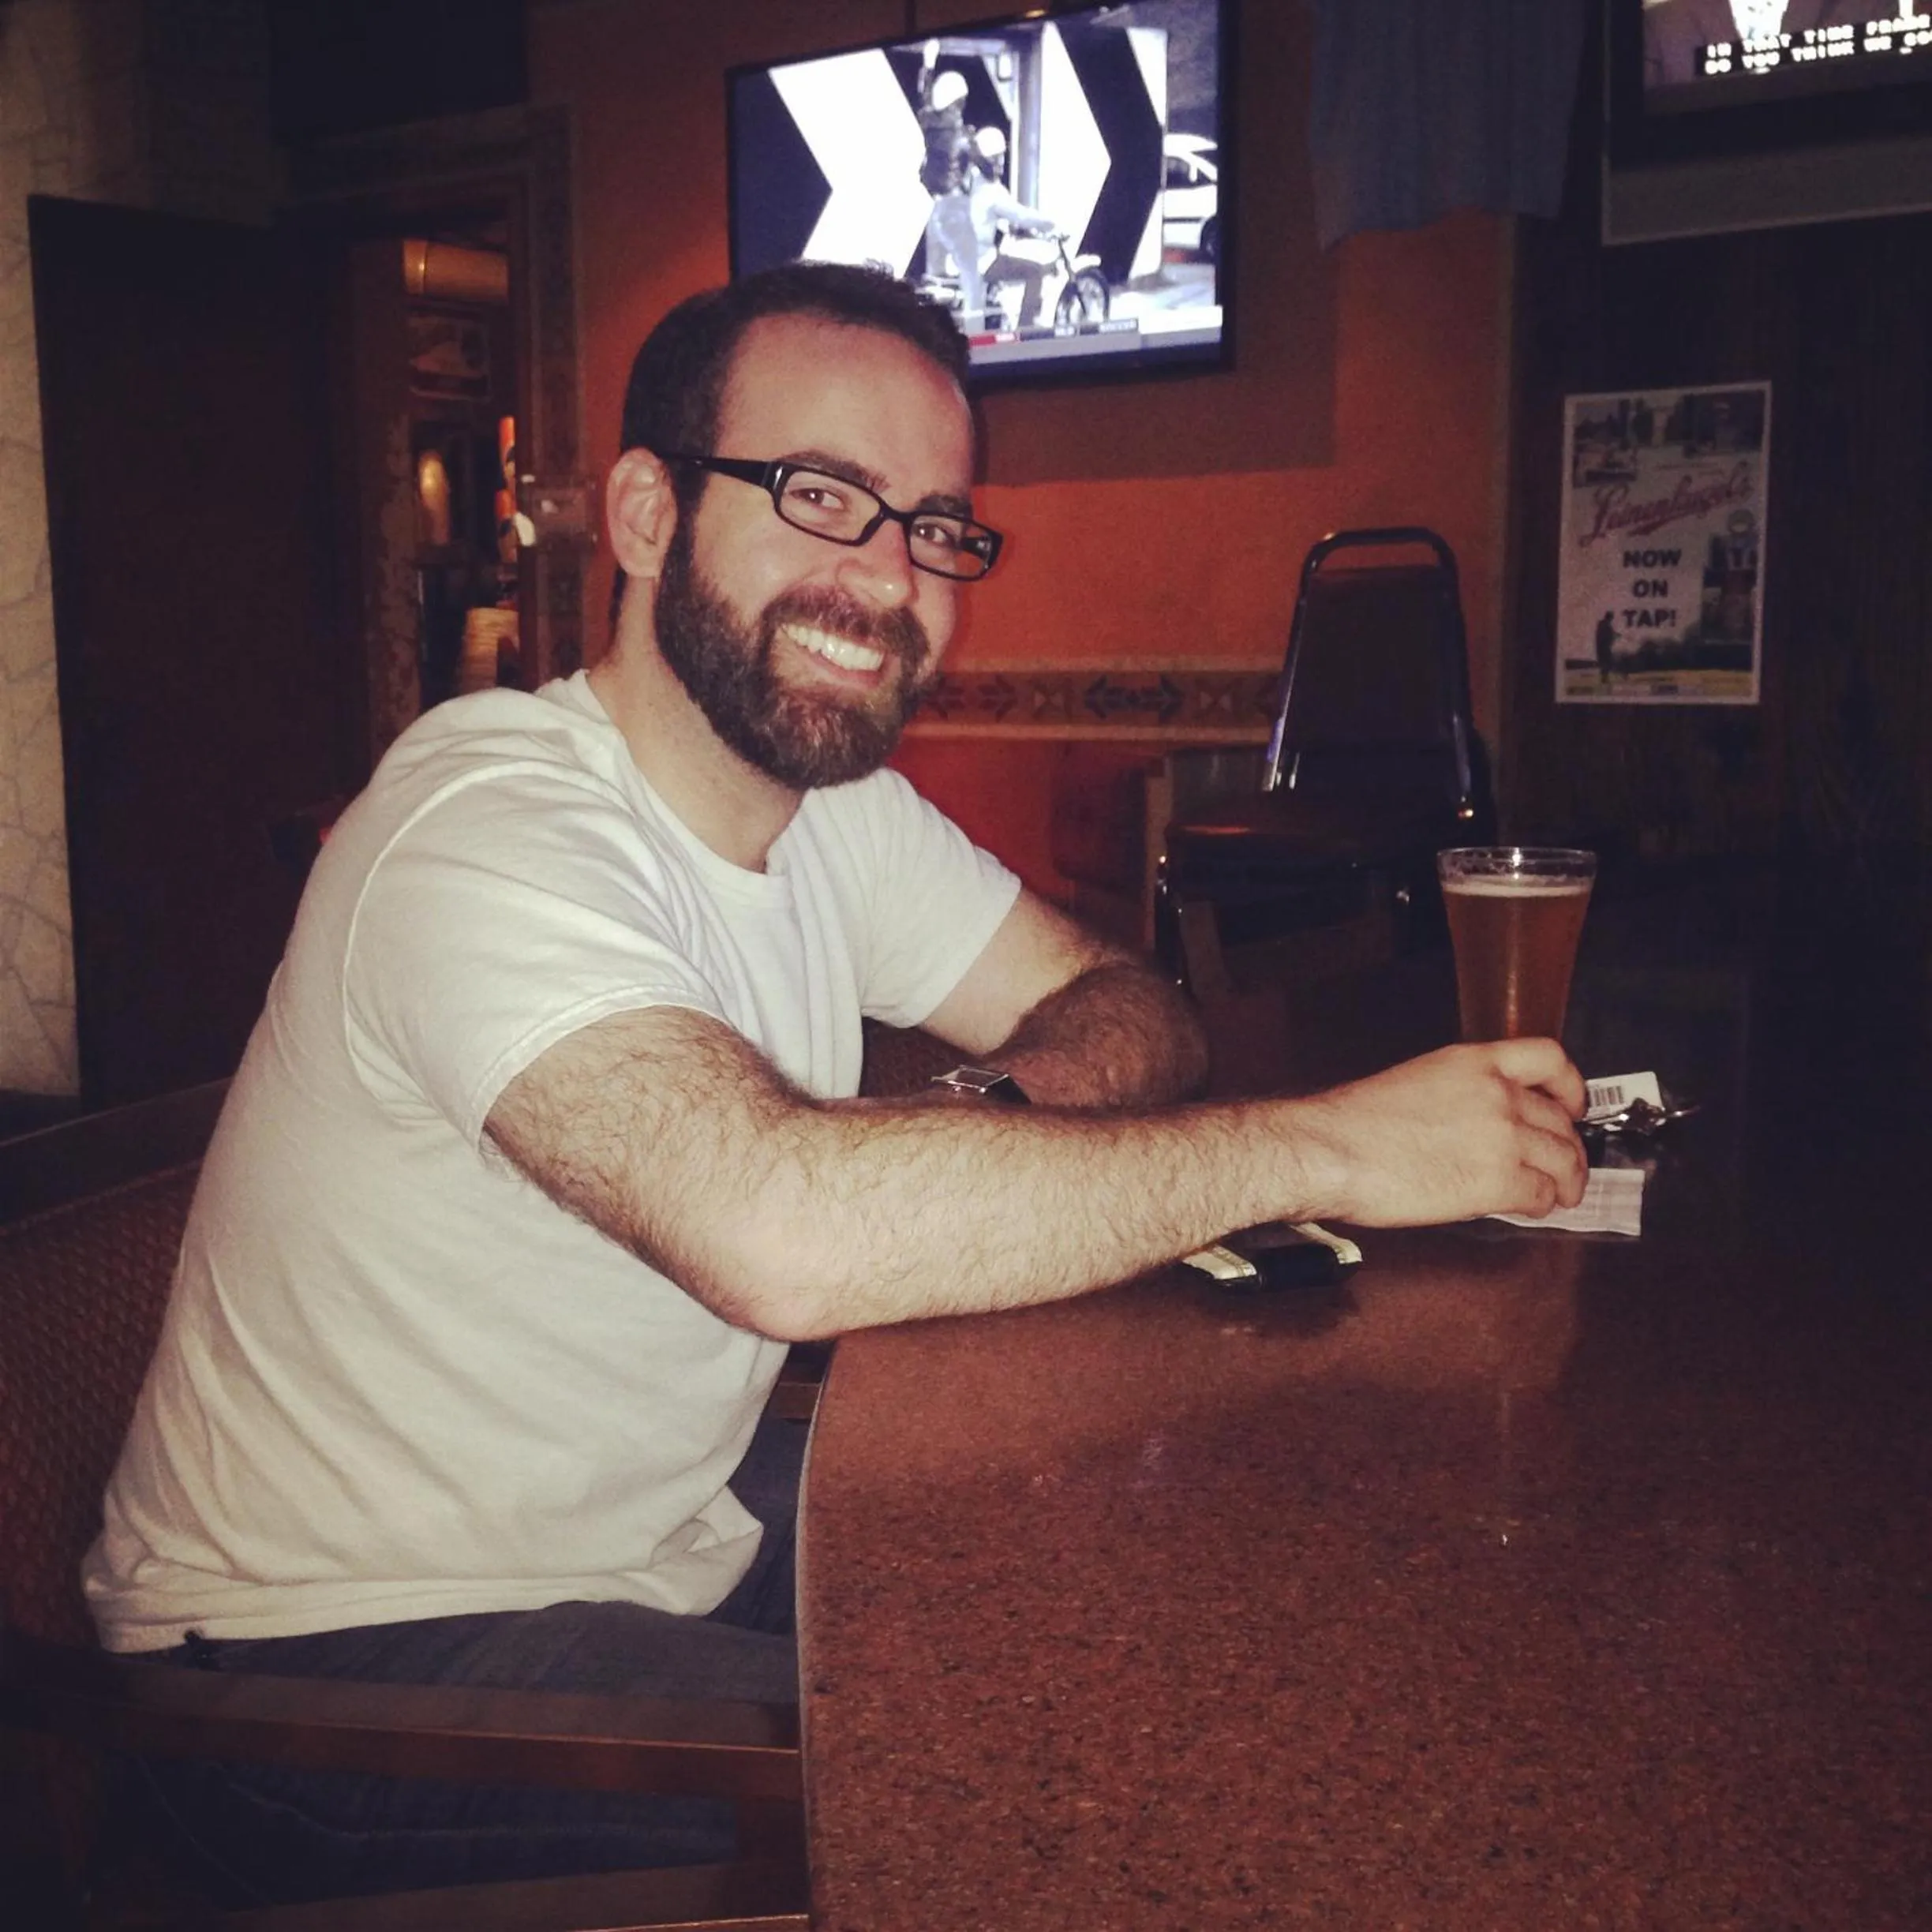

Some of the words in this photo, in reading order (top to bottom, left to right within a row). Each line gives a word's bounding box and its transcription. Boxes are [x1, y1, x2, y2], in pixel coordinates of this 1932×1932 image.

[1623, 549, 1682, 568] NOW
[1633, 579, 1668, 598] ON
[1623, 608, 1676, 628] TAP!
